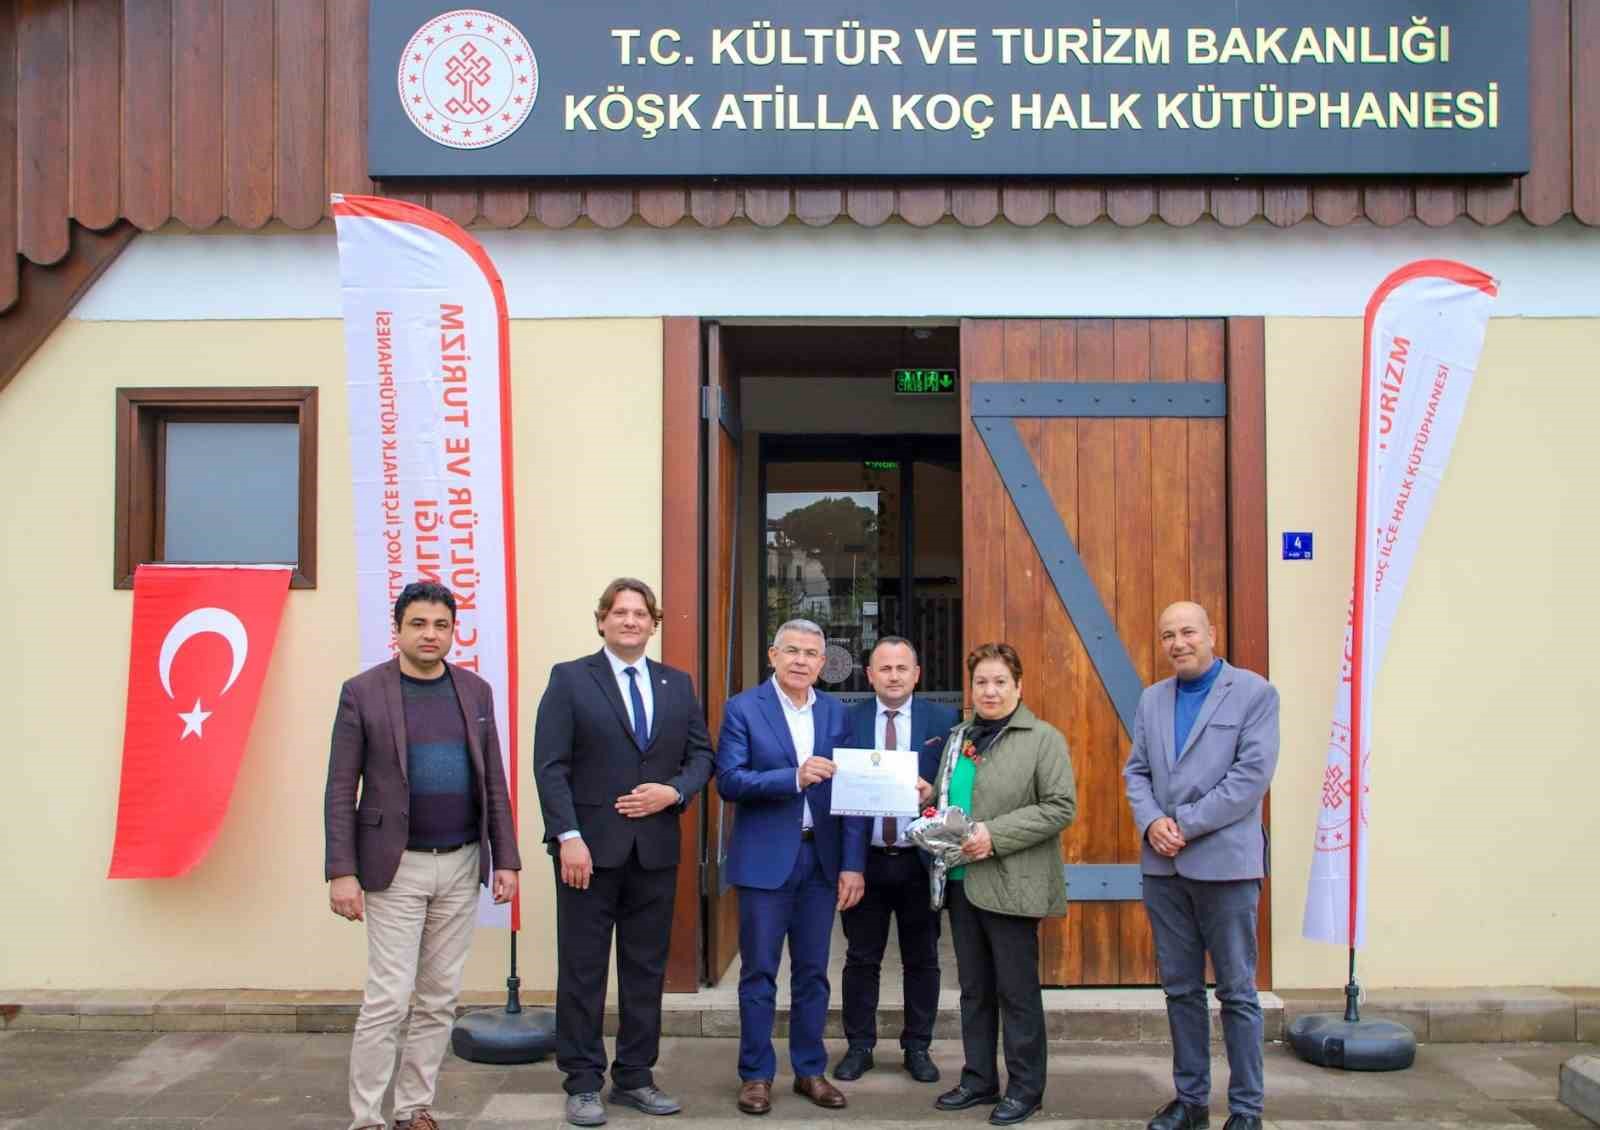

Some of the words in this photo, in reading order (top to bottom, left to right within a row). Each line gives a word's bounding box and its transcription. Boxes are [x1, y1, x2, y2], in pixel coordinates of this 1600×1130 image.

[612, 29, 693, 64] T.C.
[712, 21, 902, 65] KÜLTÜR
[915, 29, 977, 64] VE
[992, 19, 1170, 64] TURİZM
[1187, 16, 1449, 64] BAKANLIĞI
[565, 86, 701, 138] KÖŞK
[712, 85, 880, 130] ATİLLA
[893, 94, 994, 138] KOÇ
[1011, 94, 1142, 129] HALK
[1157, 83, 1498, 129] KÜTÜPHANESİ
[1379, 336, 1410, 449] URİZM
[1392, 479, 1414, 521] HALK
[1294, 535, 1302, 549] 4
